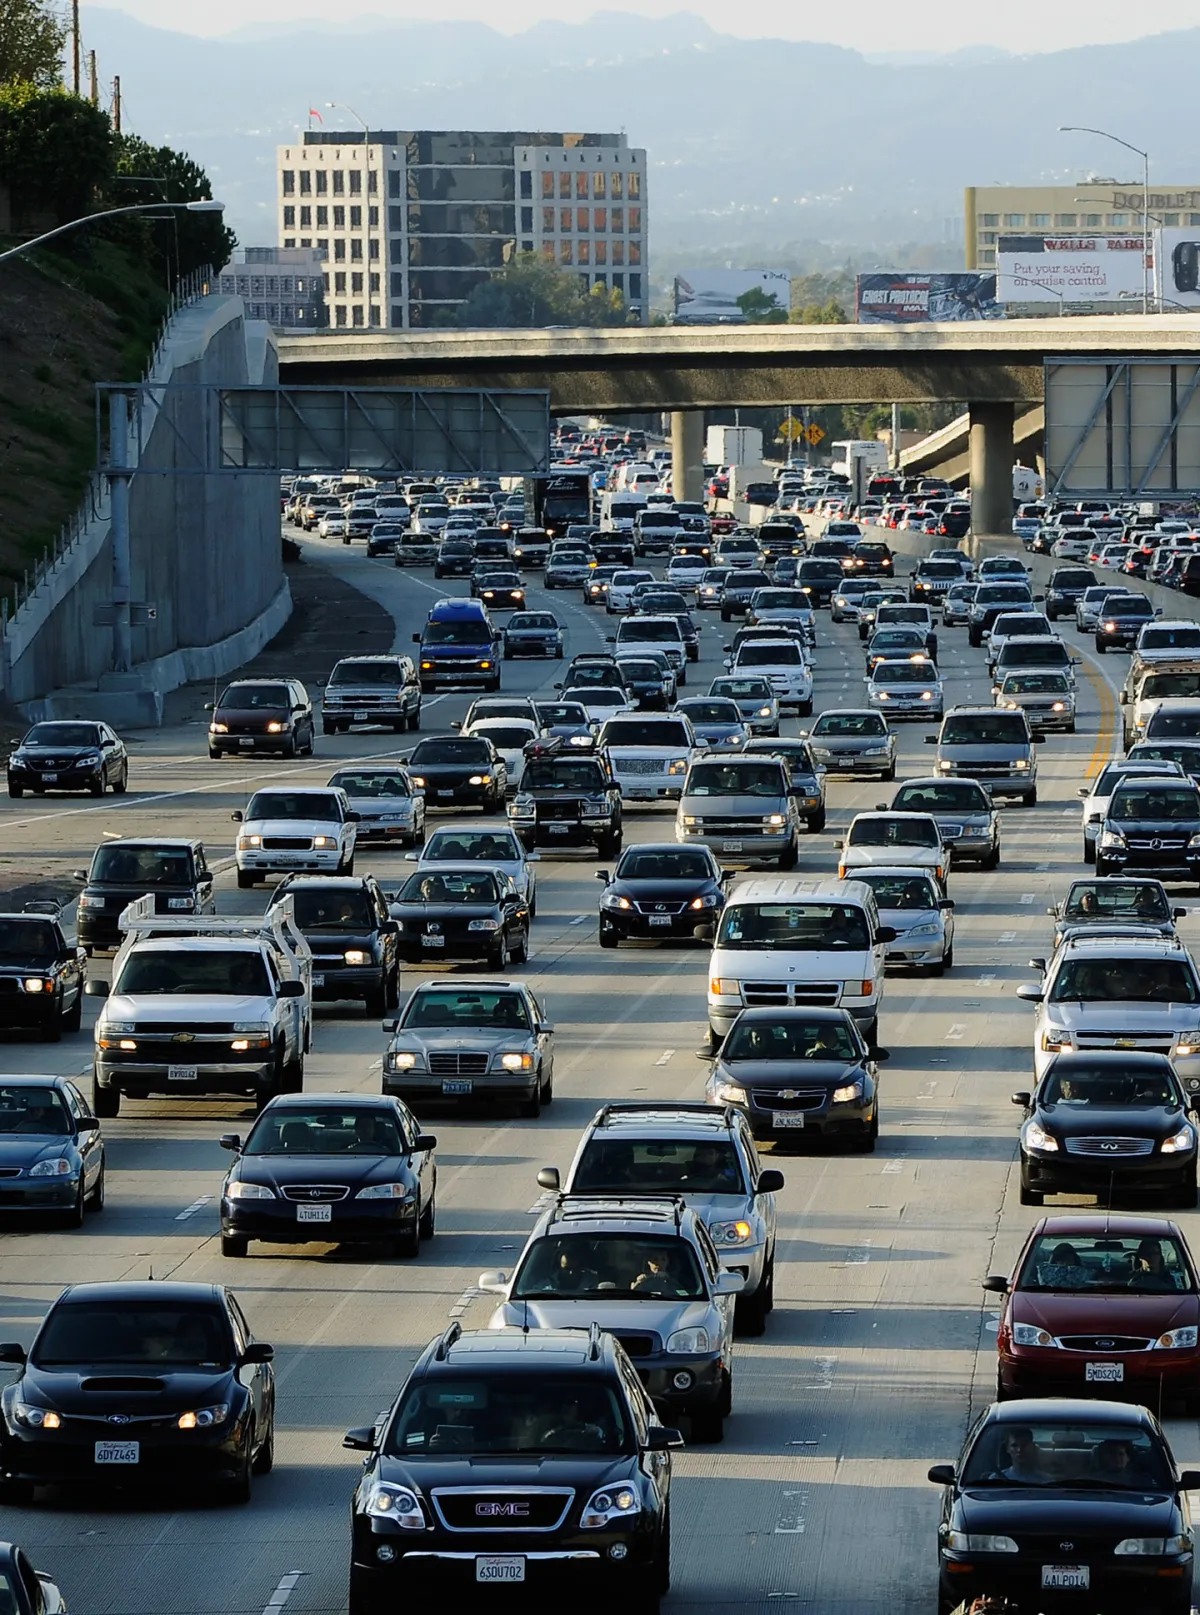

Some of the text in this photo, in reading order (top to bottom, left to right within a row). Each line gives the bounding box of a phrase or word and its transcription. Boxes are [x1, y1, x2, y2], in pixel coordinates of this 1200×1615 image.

[1045, 239, 1095, 250] WELLS
[1014, 262, 1034, 274] Put
[1035, 266, 1062, 277] your
[1014, 274, 1107, 286] on cruise control
[299, 1211, 330, 1220] 4TUH116
[1087, 1369, 1122, 1379] 5MDS204
[97, 1449, 136, 1460] 6DYZ465
[475, 1502, 530, 1516] GMC
[1044, 1575, 1086, 1586] 4ALP014
